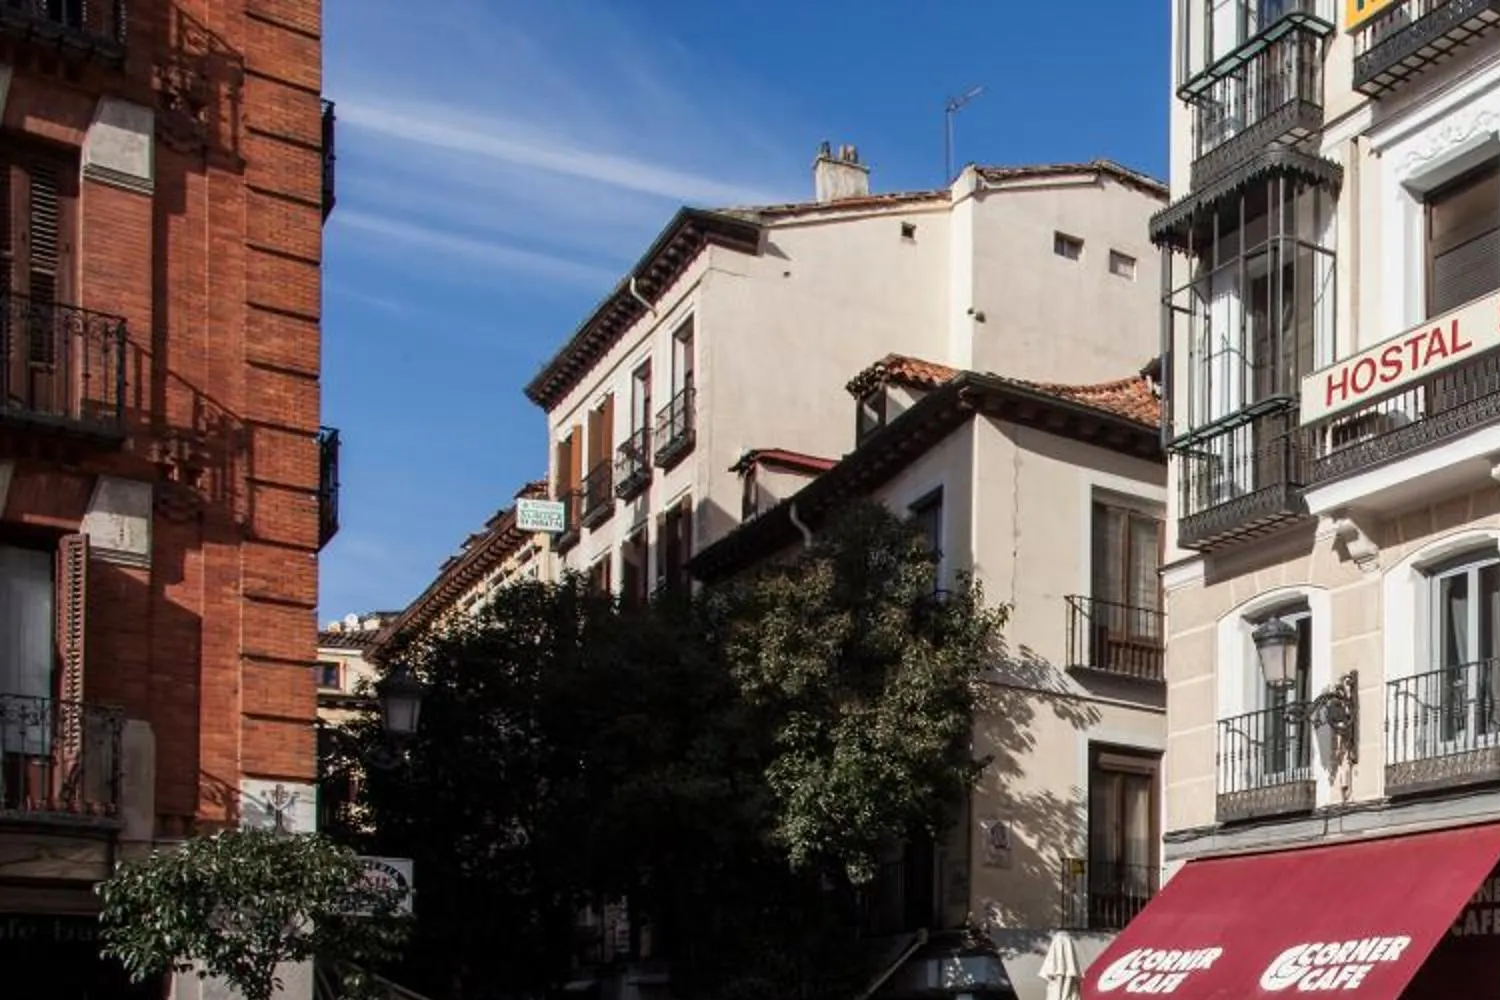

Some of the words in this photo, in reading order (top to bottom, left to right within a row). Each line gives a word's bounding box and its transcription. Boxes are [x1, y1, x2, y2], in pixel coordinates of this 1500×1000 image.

[1324, 318, 1473, 407] HOSTAL
[1300, 935, 1412, 965] CORNER
[1298, 963, 1376, 993] CAFE
